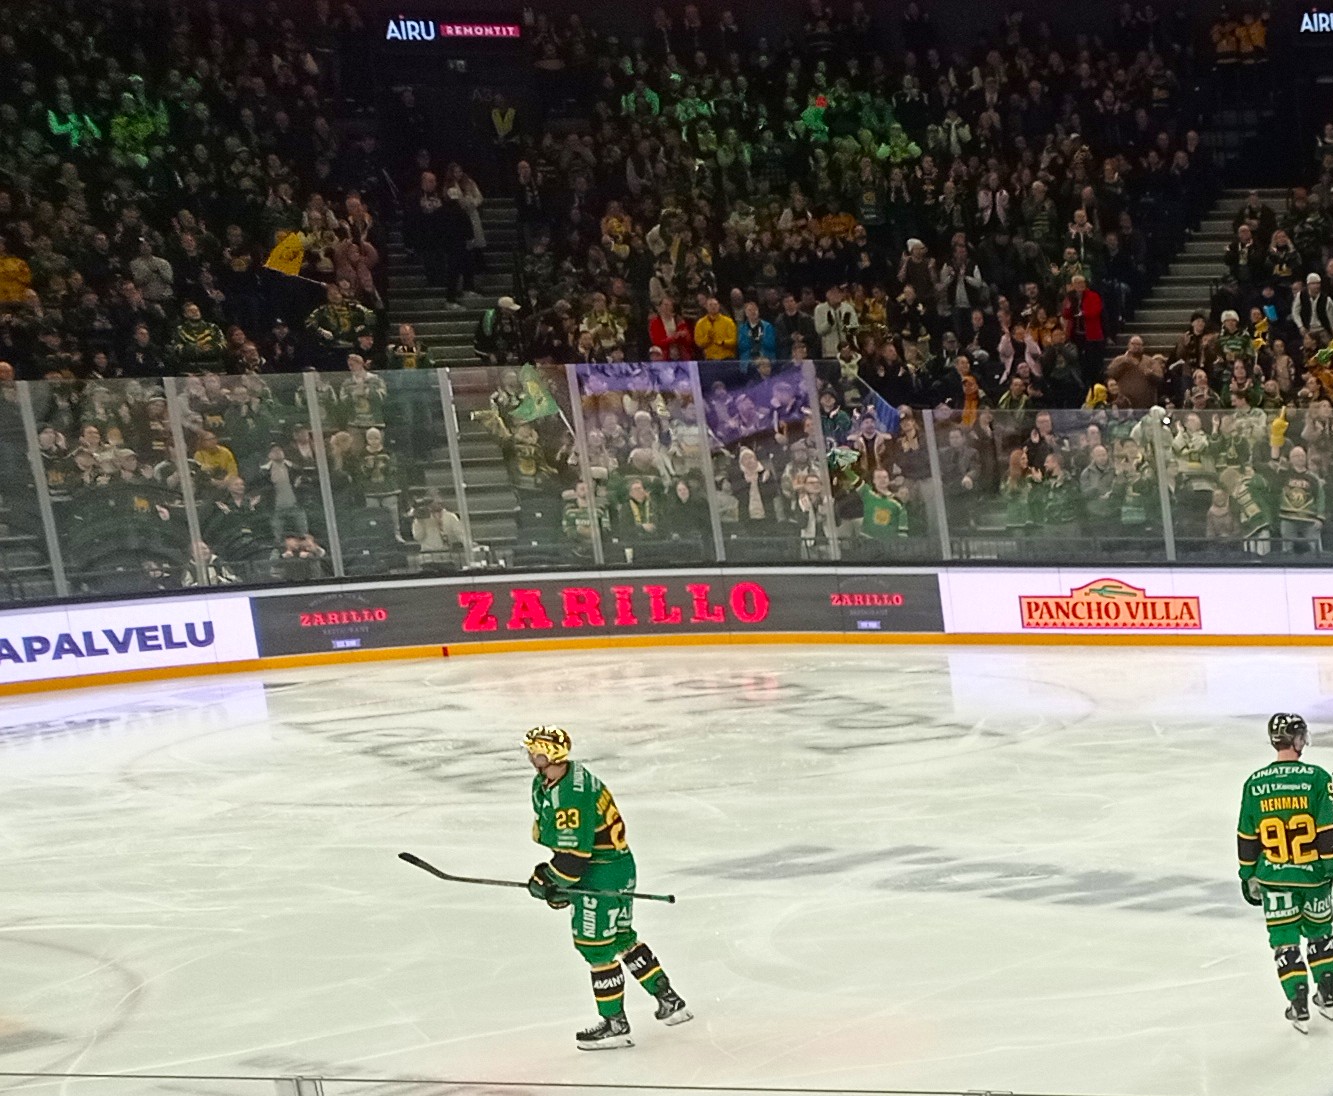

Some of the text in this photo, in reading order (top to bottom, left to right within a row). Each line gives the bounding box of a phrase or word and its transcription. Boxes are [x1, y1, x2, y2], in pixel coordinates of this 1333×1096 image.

[445, 24, 516, 36] REMONTIT
[458, 581, 770, 632] ZARILLO
[831, 593, 904, 607] ZARILLO
[300, 608, 388, 628] ZARILLO
[1027, 601, 1196, 621] PANCHO VILLA
[0, 621, 216, 665] APALVELU
[1260, 796, 1308, 812] HENMAN
[555, 808, 580, 830] 23
[1259, 813, 1319, 865] 92
